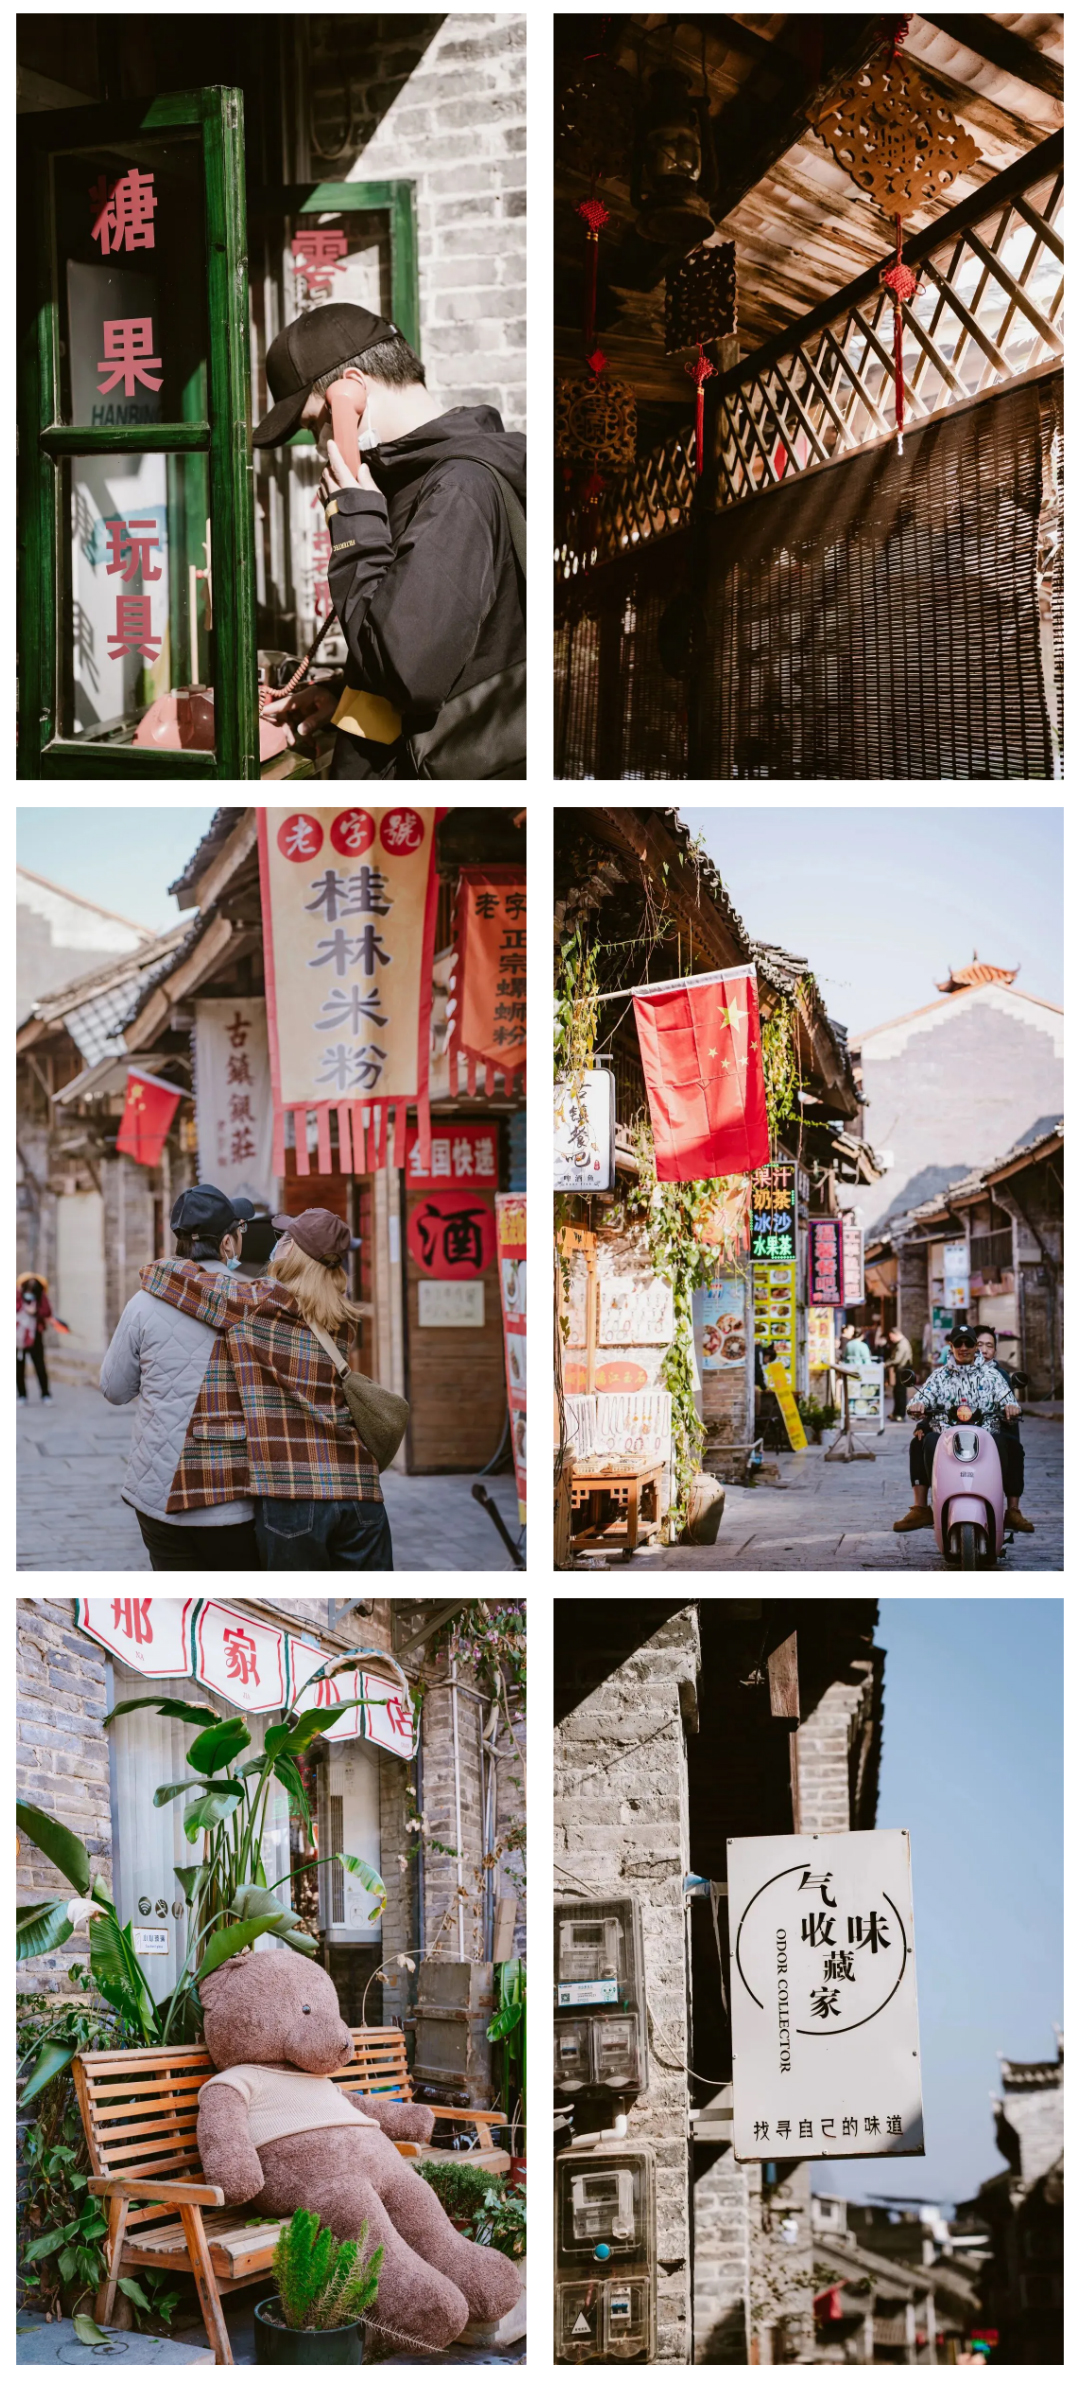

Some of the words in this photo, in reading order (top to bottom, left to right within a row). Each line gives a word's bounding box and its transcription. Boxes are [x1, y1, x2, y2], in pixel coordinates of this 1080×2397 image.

[88, 168, 164, 397] 糖果
[105, 519, 163, 663] 玩具
[285, 812, 421, 858] 老字號
[304, 866, 392, 1092] 桂林米粉
[753, 1167, 792, 1187] 果汁
[753, 1189, 792, 1210] 奶茶
[416, 1203, 488, 1270] 酒
[753, 1235, 793, 1256] 水果茶
[754, 1212, 792, 1233] 冰沙
[776, 1928, 789, 1976] ODOR
[778, 1978, 793, 2074] COLLECTOR
[753, 2114, 905, 2142] 找寻自己的味道
